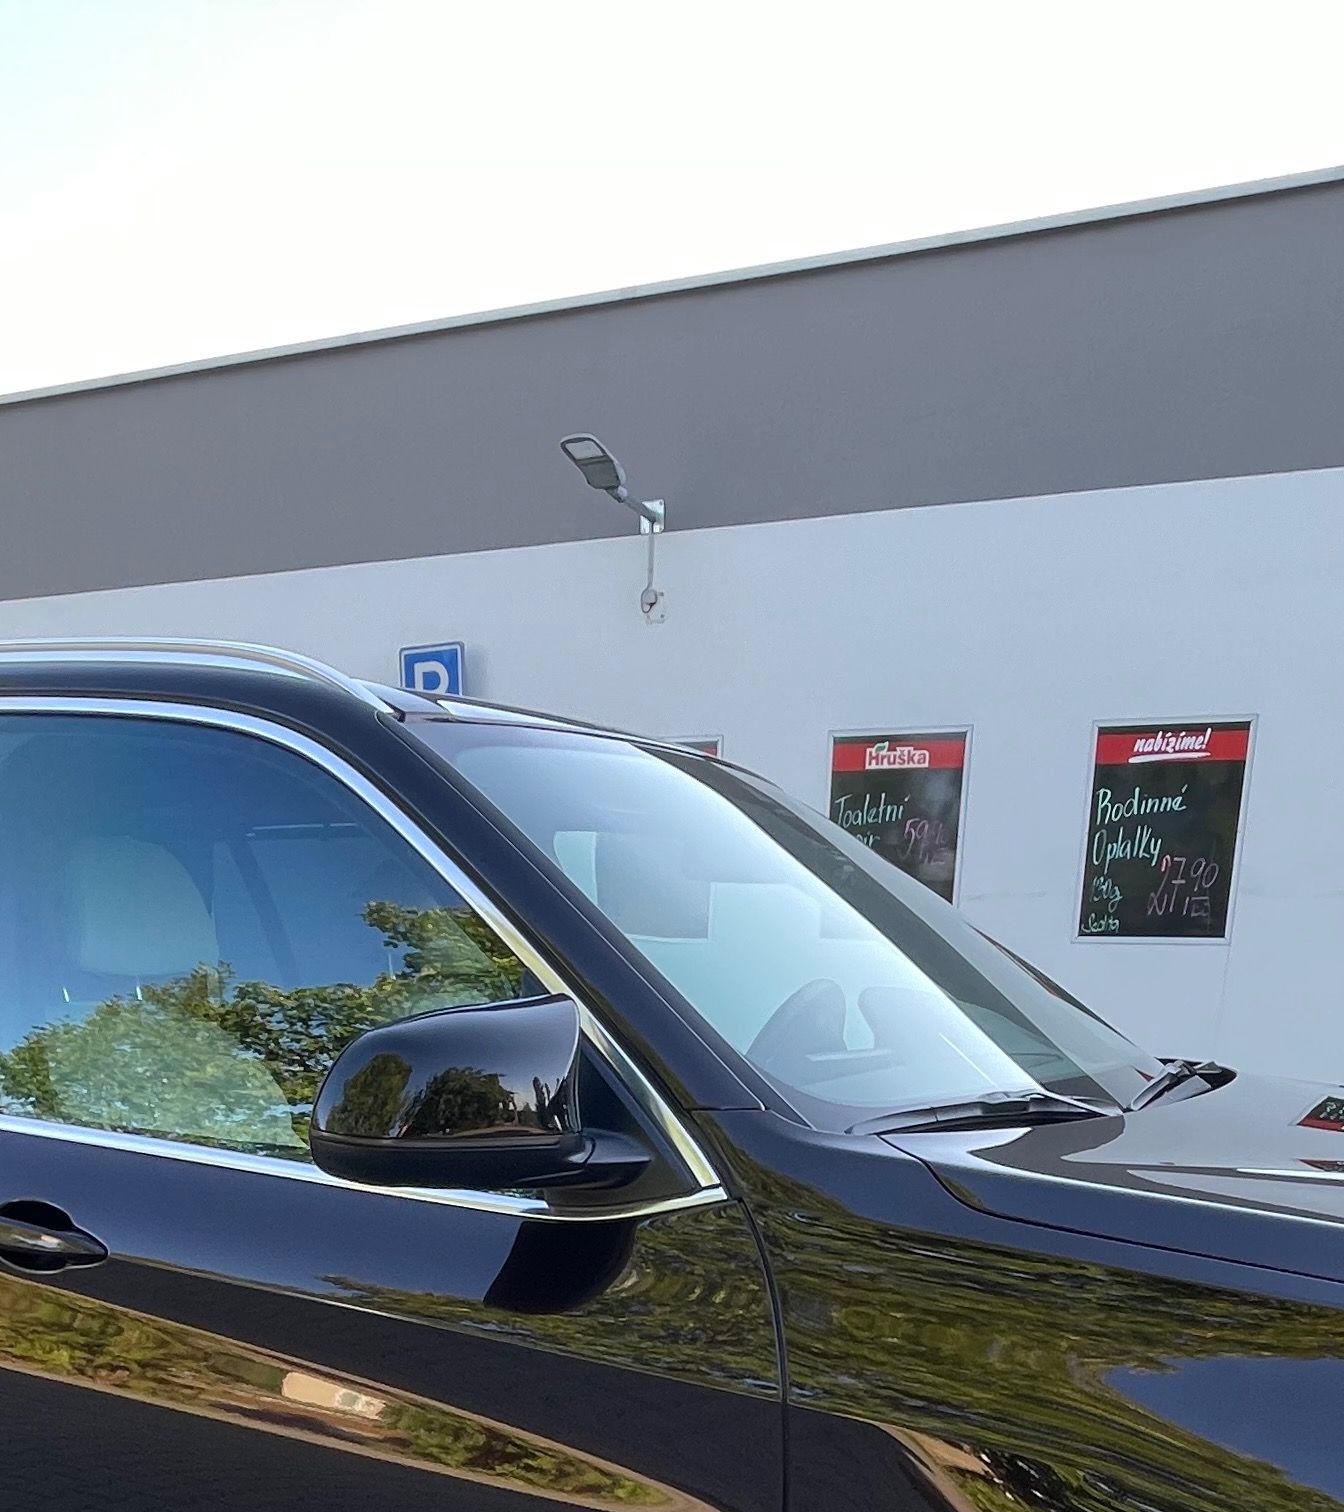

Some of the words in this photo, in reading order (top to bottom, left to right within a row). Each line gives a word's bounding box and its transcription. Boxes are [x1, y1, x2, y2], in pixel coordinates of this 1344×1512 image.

[1134, 727, 1212, 753] nabízíme!
[867, 748, 927, 767] Hruška
[1096, 784, 1187, 825] Rodinné
